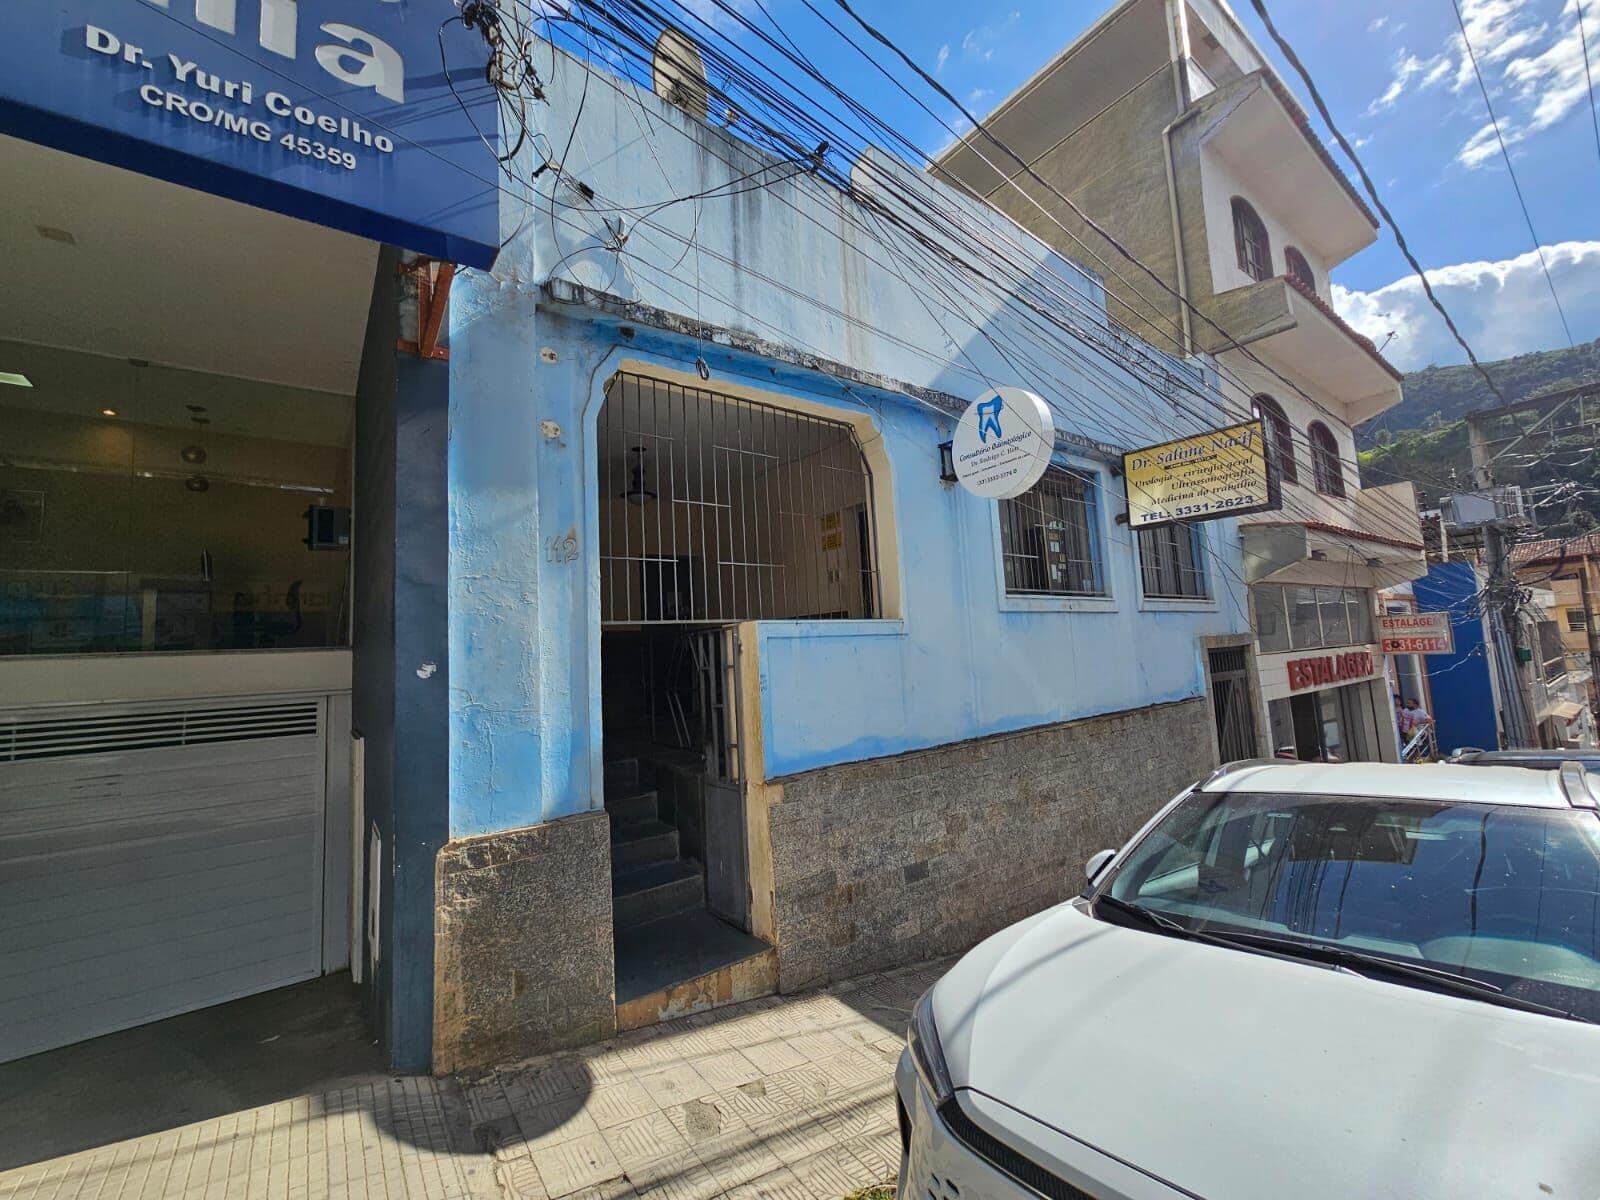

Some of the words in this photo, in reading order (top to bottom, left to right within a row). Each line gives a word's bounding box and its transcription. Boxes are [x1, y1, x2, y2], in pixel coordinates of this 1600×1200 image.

[85, 24, 153, 70] Dr.
[168, 53, 252, 105] Yuri
[265, 91, 395, 153] Coelho
[139, 83, 272, 142] CRO/MG
[280, 133, 357, 170] 45359
[1132, 457, 1152, 471] Dr.
[1135, 473, 1173, 488] Urologia
[1151, 490, 1195, 506] Medicina
[1175, 495, 1255, 516] 3331-2623
[1385, 638, 1447, 652] 331-6114
[1287, 652, 1374, 691] ESTALAGEM
